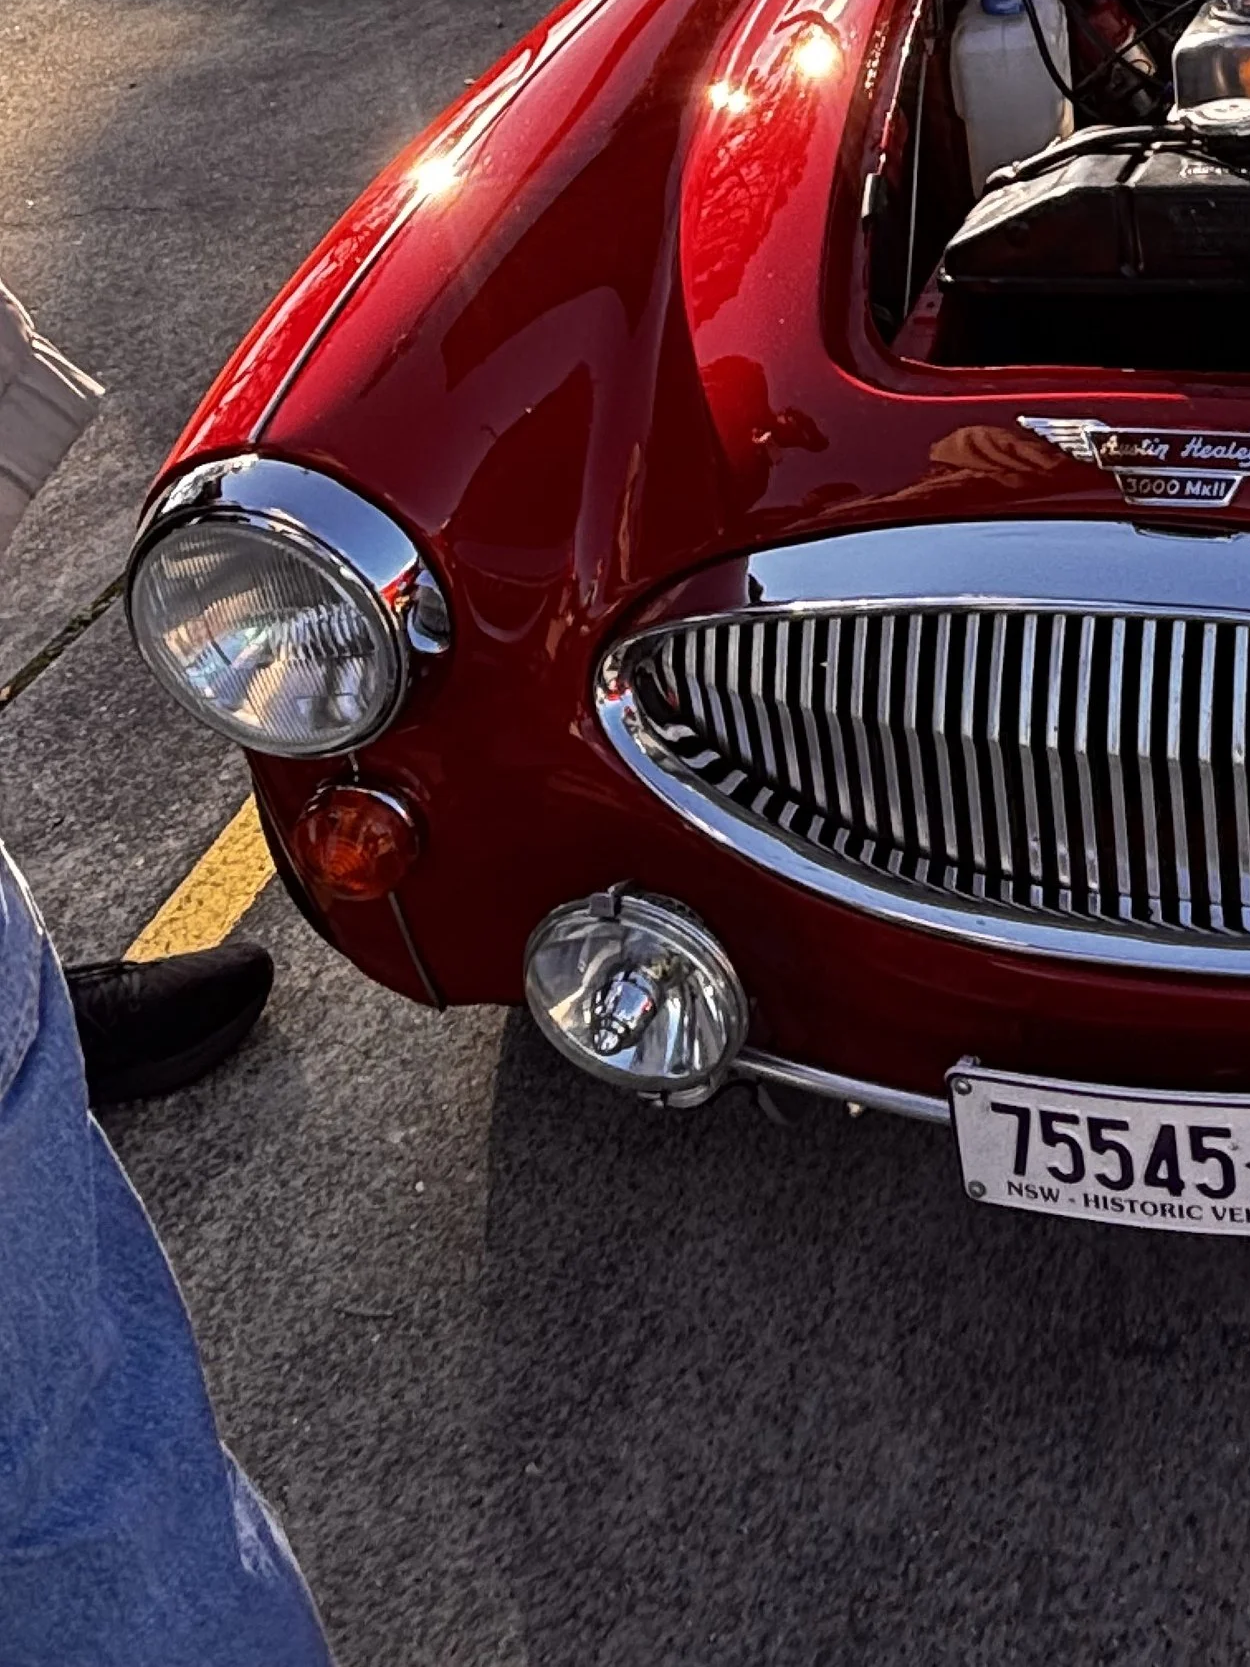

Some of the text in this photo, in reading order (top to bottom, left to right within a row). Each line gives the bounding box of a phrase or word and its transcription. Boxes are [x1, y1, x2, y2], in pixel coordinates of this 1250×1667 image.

[1100, 435, 1169, 461] Austin
[1126, 477, 1180, 495] 3000
[1007, 1180, 1060, 1203] NSW
[1083, 1193, 1204, 1220] HISTORIC
